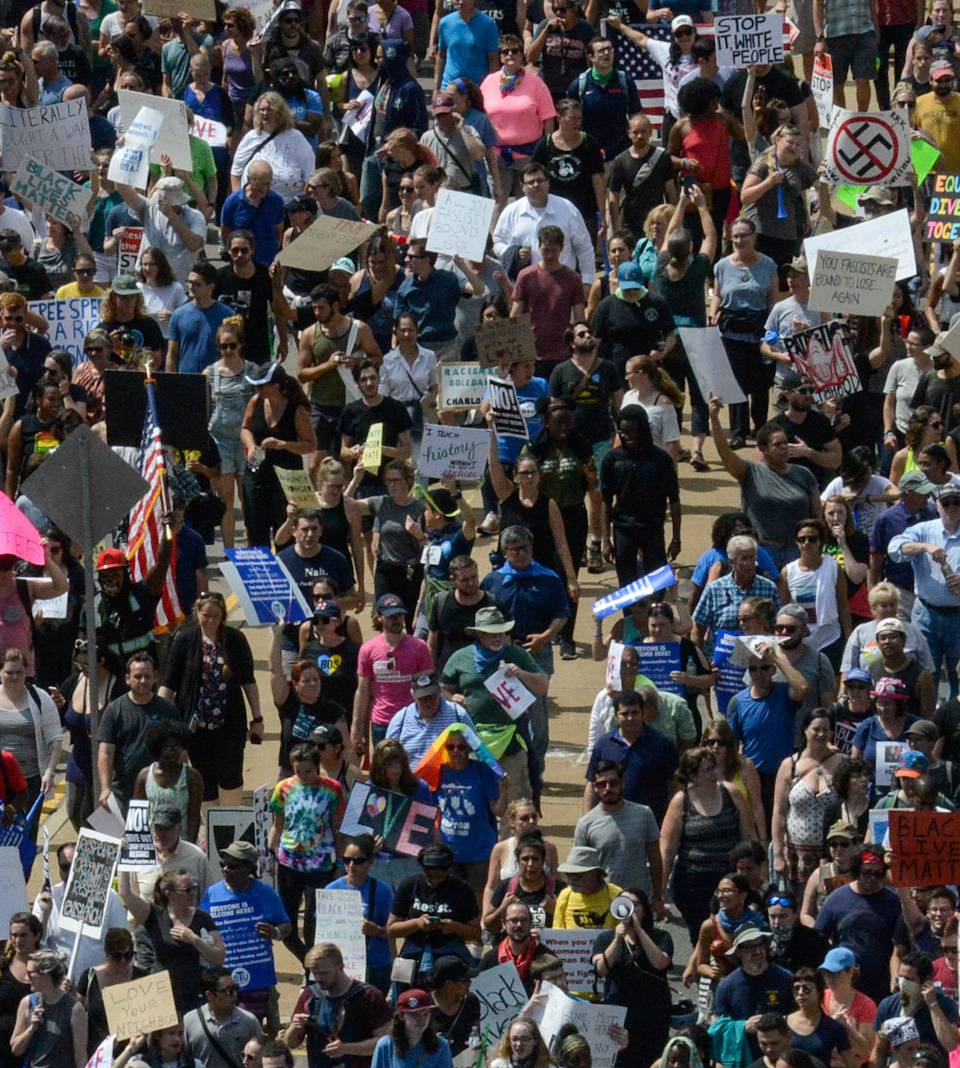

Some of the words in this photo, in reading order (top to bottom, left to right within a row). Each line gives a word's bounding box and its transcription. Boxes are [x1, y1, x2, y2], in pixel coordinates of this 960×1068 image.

[718, 17, 766, 34] STOP
[733, 32, 772, 50] WHITE
[732, 47, 783, 65] PEOPLE
[812, 76, 831, 91] STOP
[0, 101, 84, 128] LITERALLY
[820, 256, 838, 270] YOU
[841, 261, 873, 276] FASCISTS
[831, 291, 860, 305] AGAIN
[490, 385, 517, 411] NO!
[422, 440, 488, 463] history
[304, 567, 329, 577] Nah.
[321, 659, 339, 669] BOS
[125, 807, 149, 831] NO!
[412, 898, 453, 913] Resist.
[545, 938, 569, 946] When
[571, 939, 588, 947] you
[233, 970, 249, 983] BTU
[110, 981, 169, 1004] LOVE
